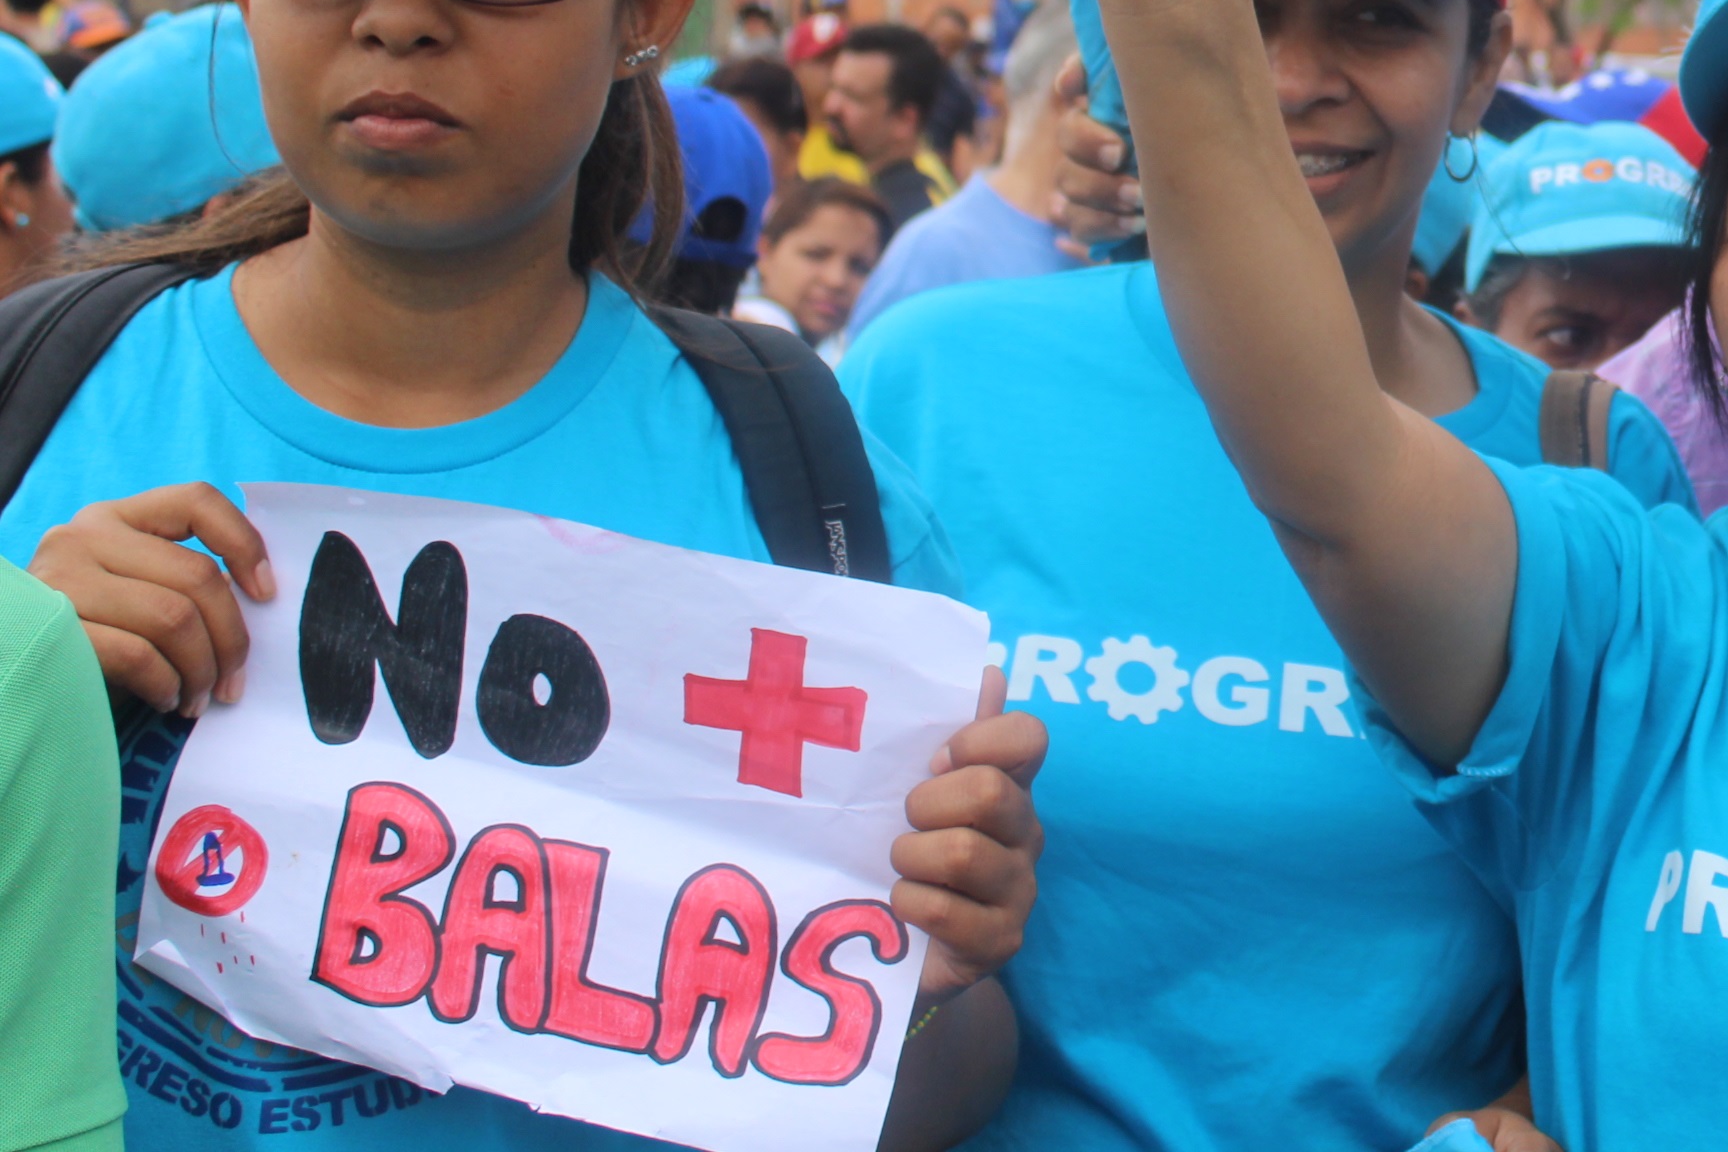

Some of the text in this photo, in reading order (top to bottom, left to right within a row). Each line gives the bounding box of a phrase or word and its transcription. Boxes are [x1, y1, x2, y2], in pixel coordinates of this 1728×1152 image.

[988, 633, 1366, 740] ROGR
[310, 780, 908, 1086] BALAS
[116, 1028, 440, 1135] GRESO ESTUD
